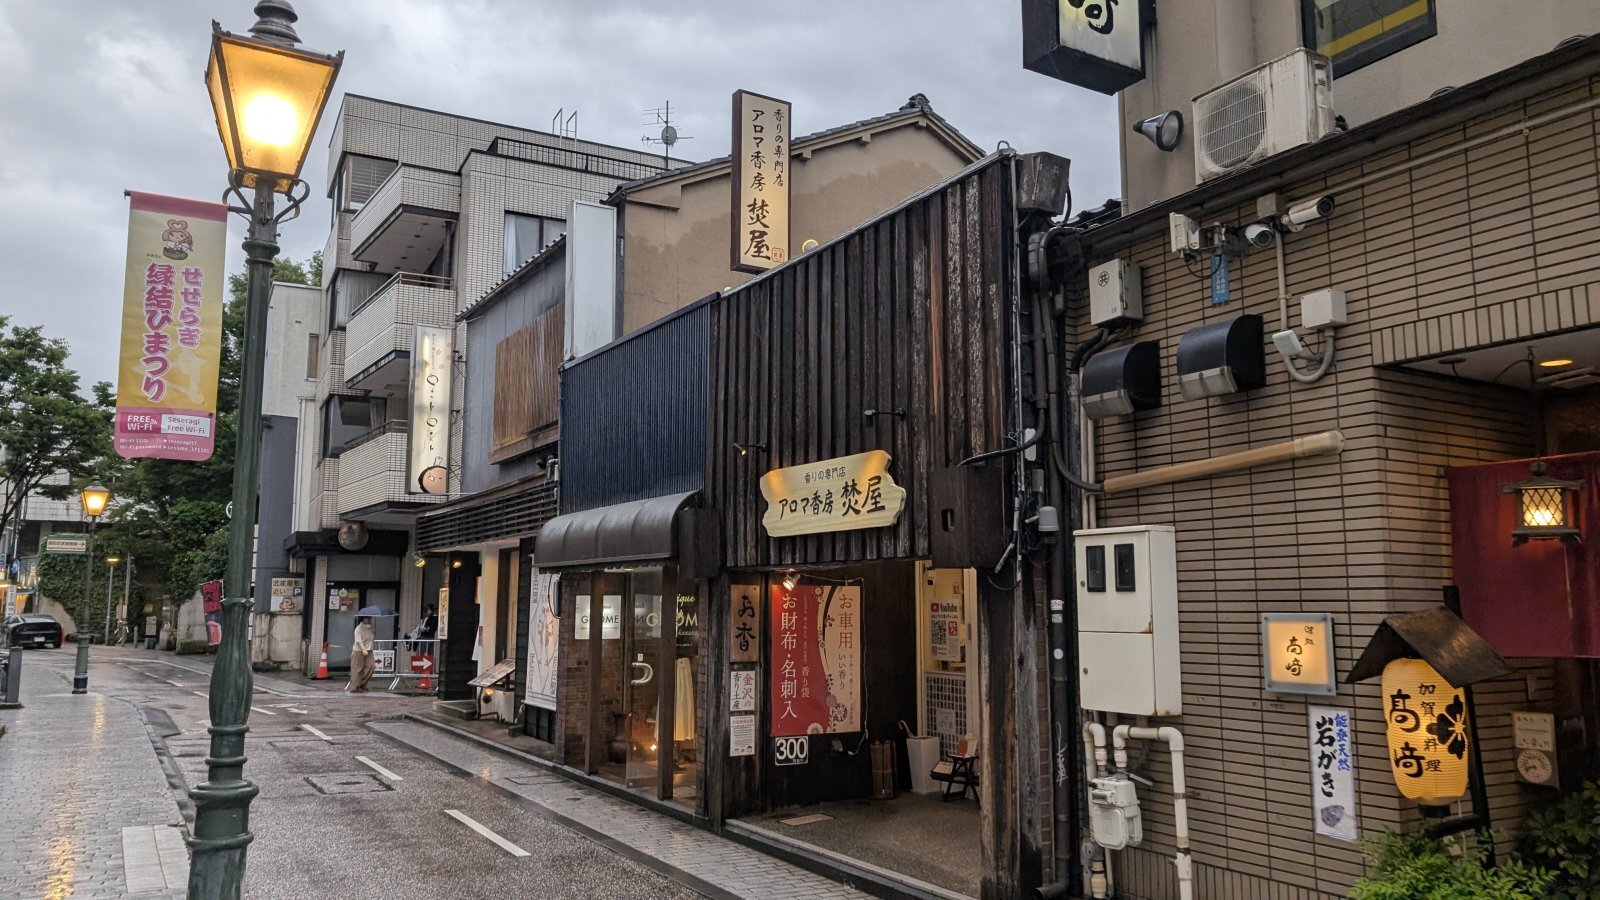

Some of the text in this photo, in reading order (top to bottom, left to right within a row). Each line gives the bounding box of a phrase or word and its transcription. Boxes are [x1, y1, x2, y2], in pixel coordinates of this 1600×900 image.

[773, 108, 785, 187] 香りの専門店
[744, 109, 771, 260] アロマ香房 焚屋
[179, 267, 203, 348] せせらぎ
[141, 263, 176, 403] 縁結びまつり
[127, 415, 151, 423] FREE
[127, 423, 152, 431] Wi-Fi
[168, 416, 200, 426] Seseragi
[185, 426, 205, 434] Wi-Fi
[779, 475, 886, 520] アロマ香房 焚屋
[804, 466, 846, 484] 香りの専門店
[735, 593, 756, 652] お香
[837, 593, 853, 690] お車用 いい香り
[780, 592, 798, 720] お財布・名刺入
[731, 672, 742, 710] 香り土産
[742, 672, 754, 708] 金沢の
[800, 666, 811, 698] 香り袋
[776, 737, 807, 761] 300
[1314, 715, 1338, 798] 岩がき
[1334, 712, 1351, 772] 能登天然
